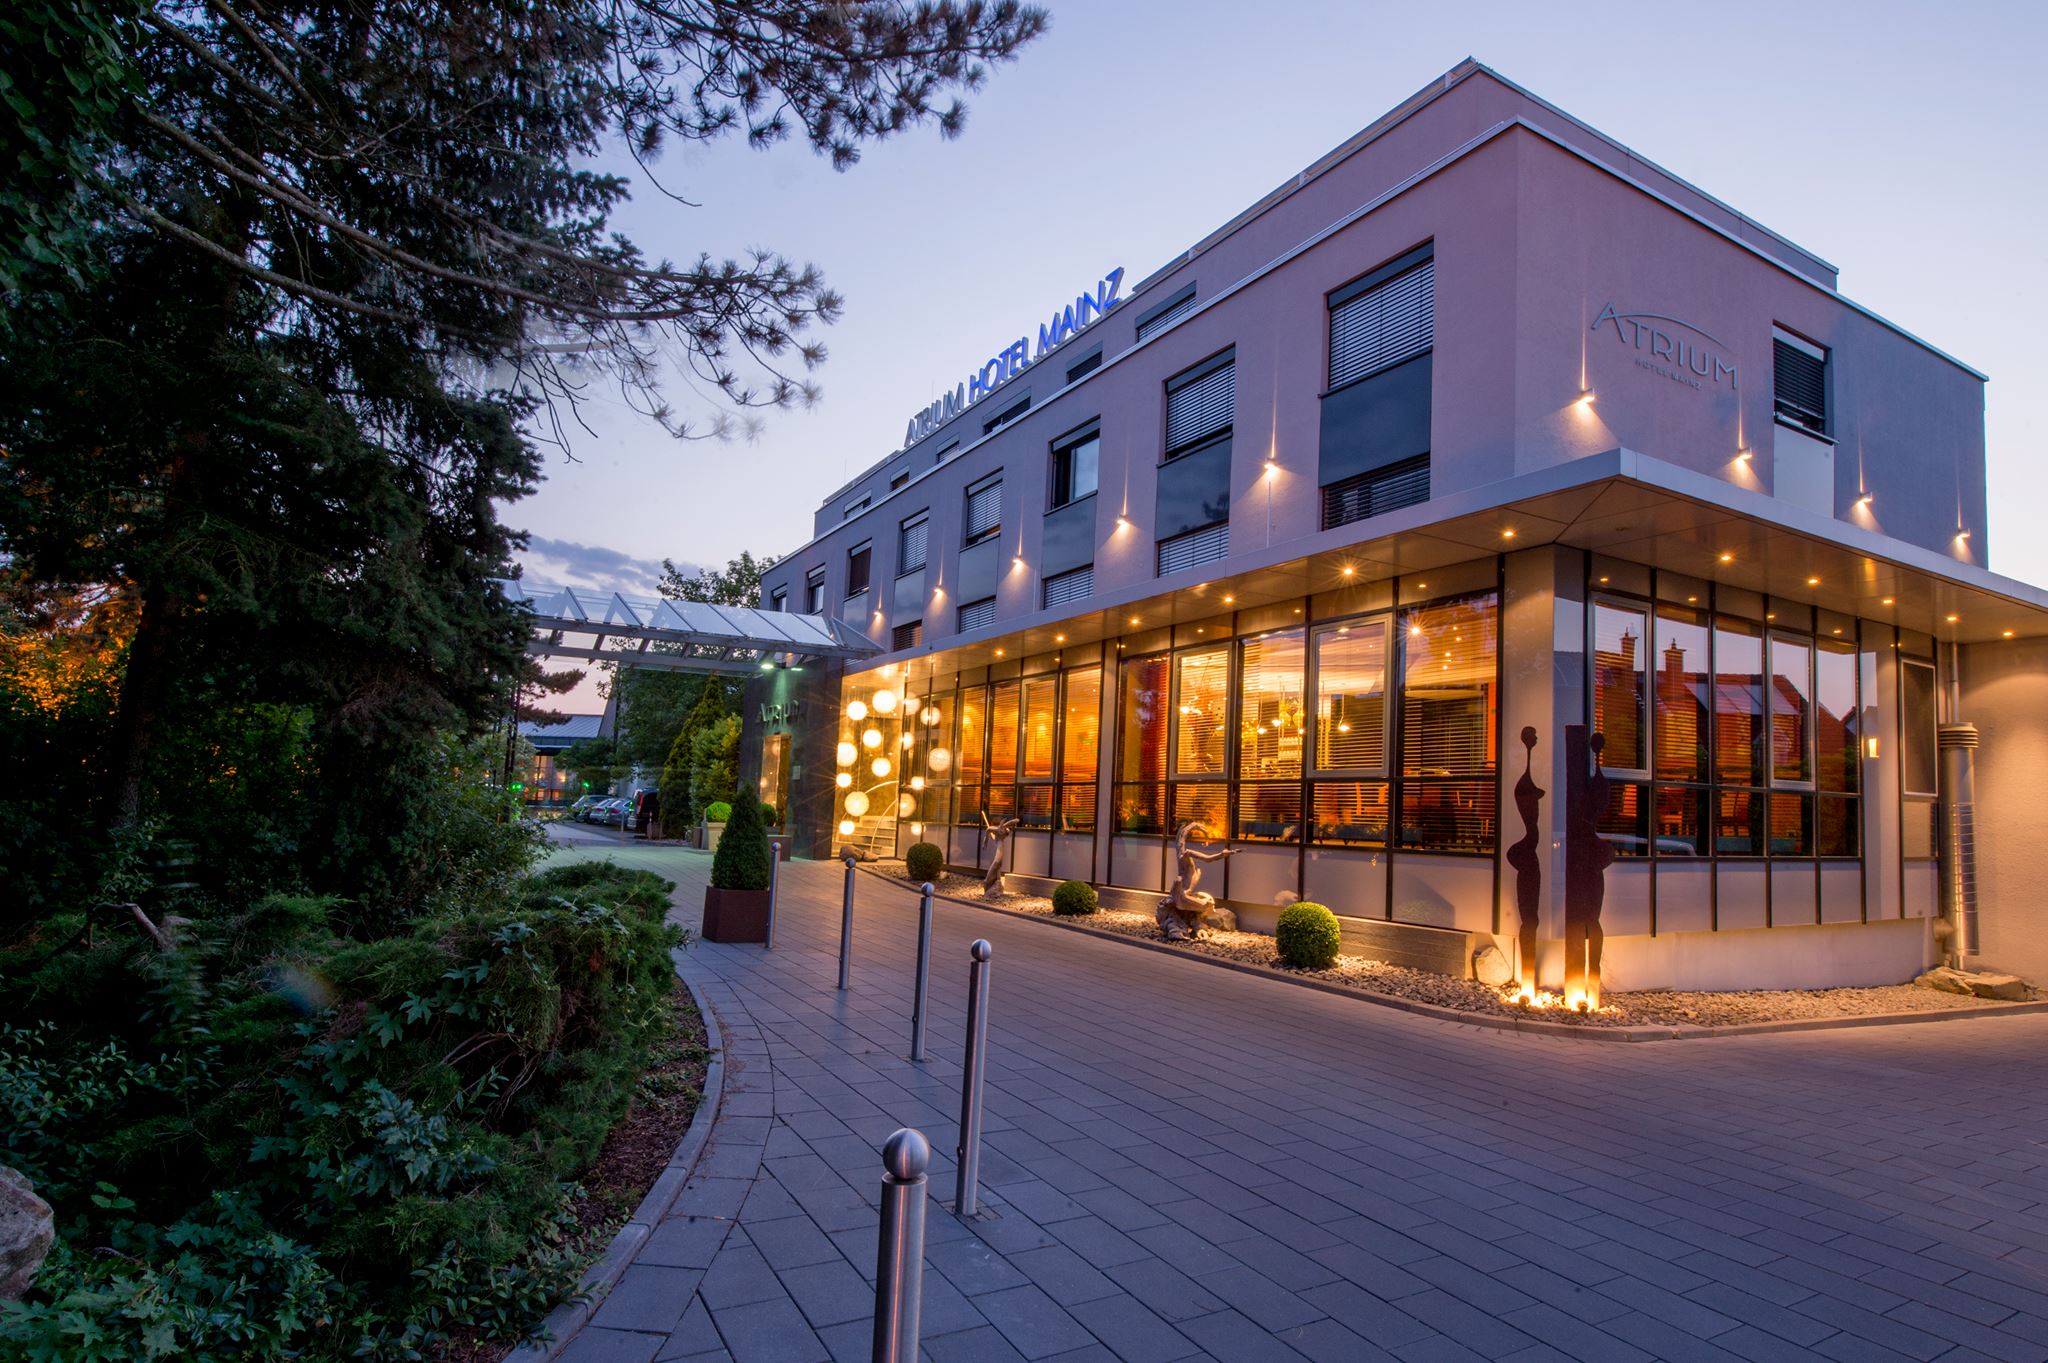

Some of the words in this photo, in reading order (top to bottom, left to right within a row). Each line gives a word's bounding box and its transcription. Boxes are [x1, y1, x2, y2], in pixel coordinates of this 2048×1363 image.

[904, 382, 965, 448] ATRIUM
[969, 336, 1033, 404] HOTEL
[1036, 266, 1125, 357] MAINZ
[1591, 302, 1738, 390] ATRIUM
